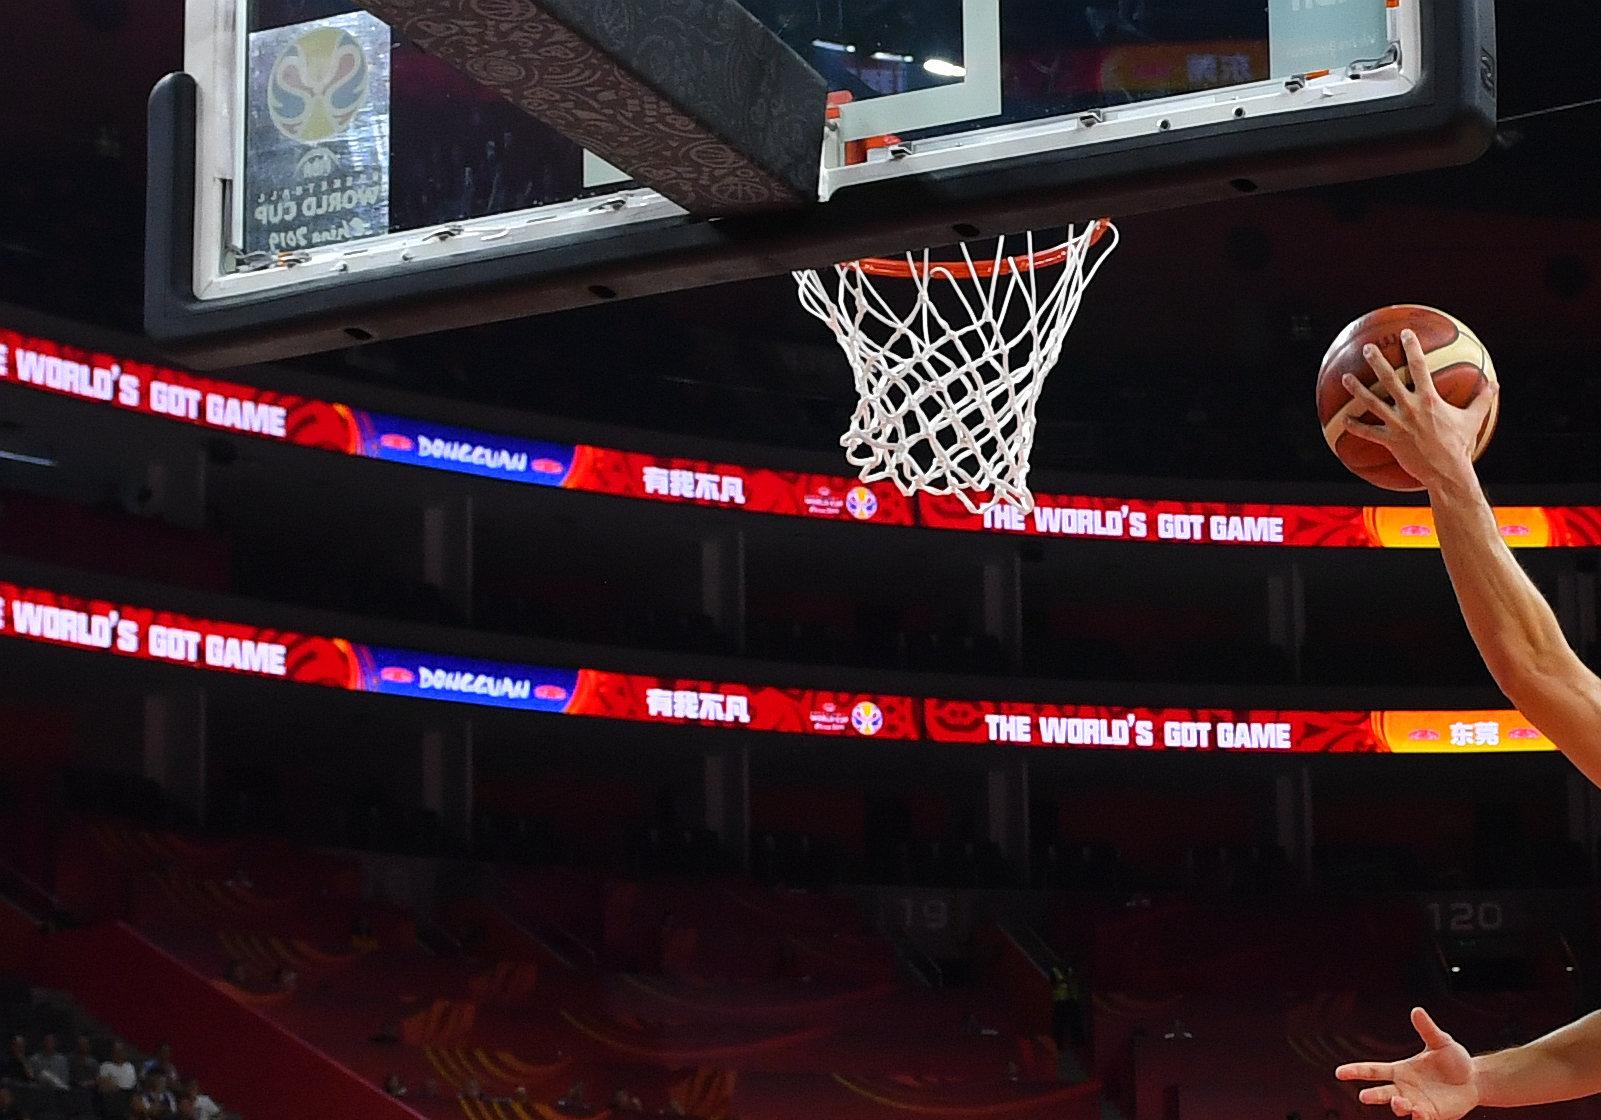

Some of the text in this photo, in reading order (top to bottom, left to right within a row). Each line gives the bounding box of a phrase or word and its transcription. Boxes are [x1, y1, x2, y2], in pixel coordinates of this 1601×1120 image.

[15, 348, 139, 407] WORLD'S
[149, 381, 201, 420] GOT
[205, 393, 287, 437] GAME
[1034, 505, 1147, 538] WORLD'S
[1157, 513, 1205, 540] GOT
[1209, 515, 1284, 543] GAME
[11, 600, 138, 653] WORLD'S
[148, 624, 202, 662] GOT
[205, 634, 287, 676] GAME
[984, 713, 1292, 749] THE WORLD'S GOT GAME
[1449, 721, 1500, 747] 东莞
